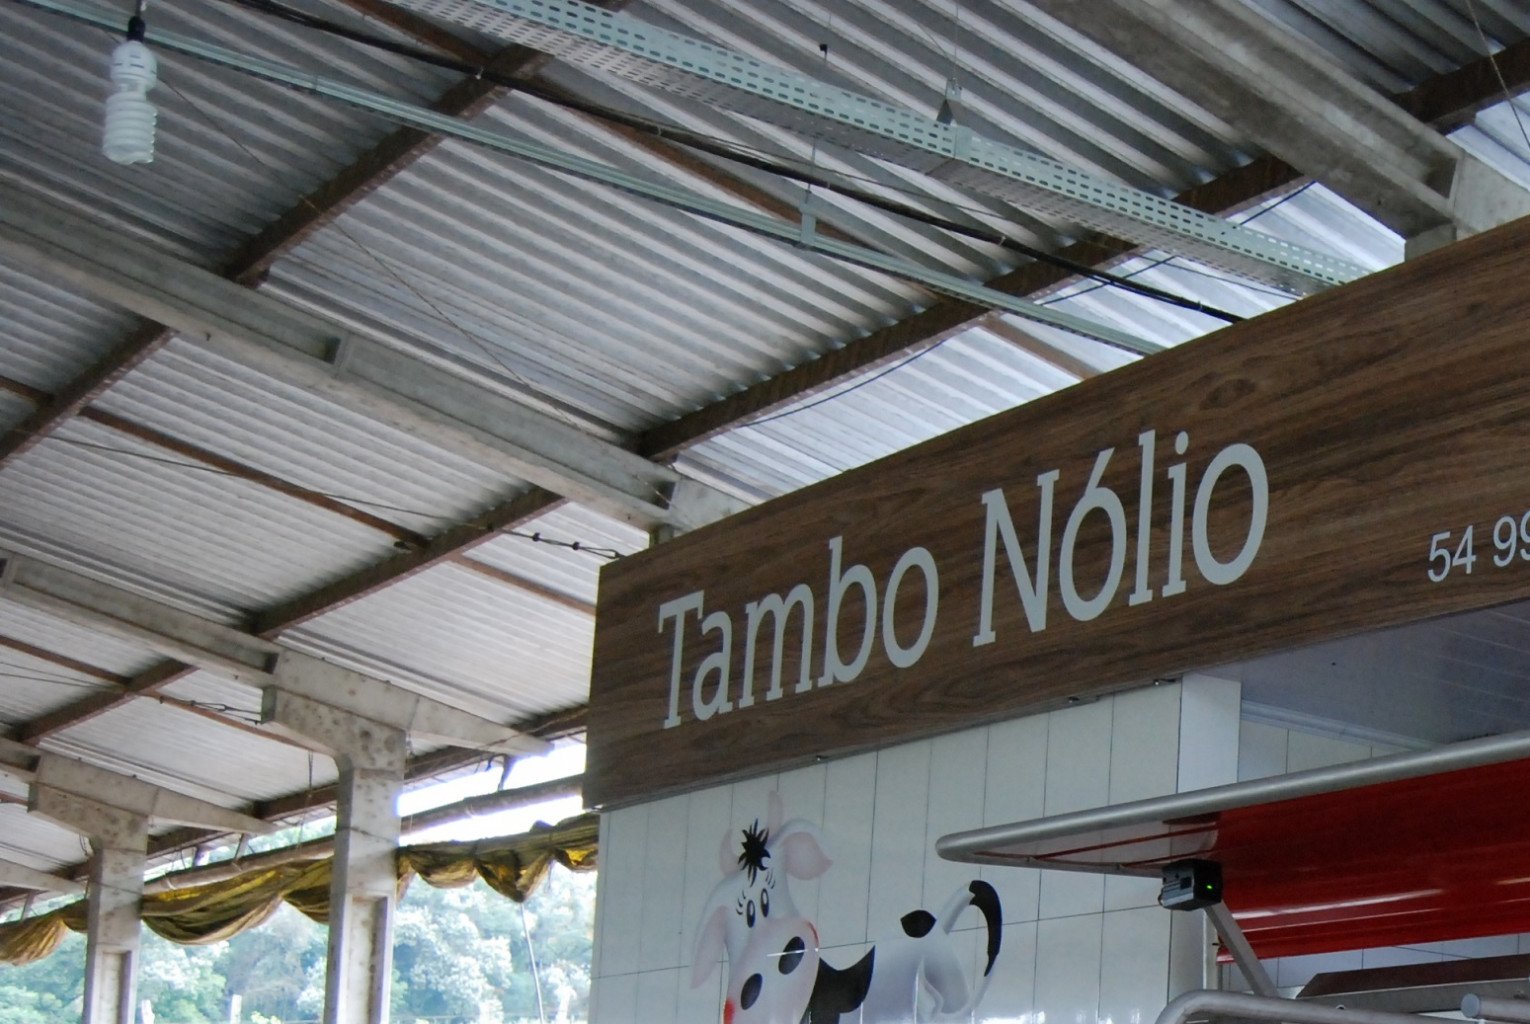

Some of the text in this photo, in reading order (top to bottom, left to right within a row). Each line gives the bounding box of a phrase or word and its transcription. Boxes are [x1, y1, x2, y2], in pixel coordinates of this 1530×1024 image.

[658, 429, 1269, 729] Tambo Nólio
[1427, 525, 1477, 583] 54
